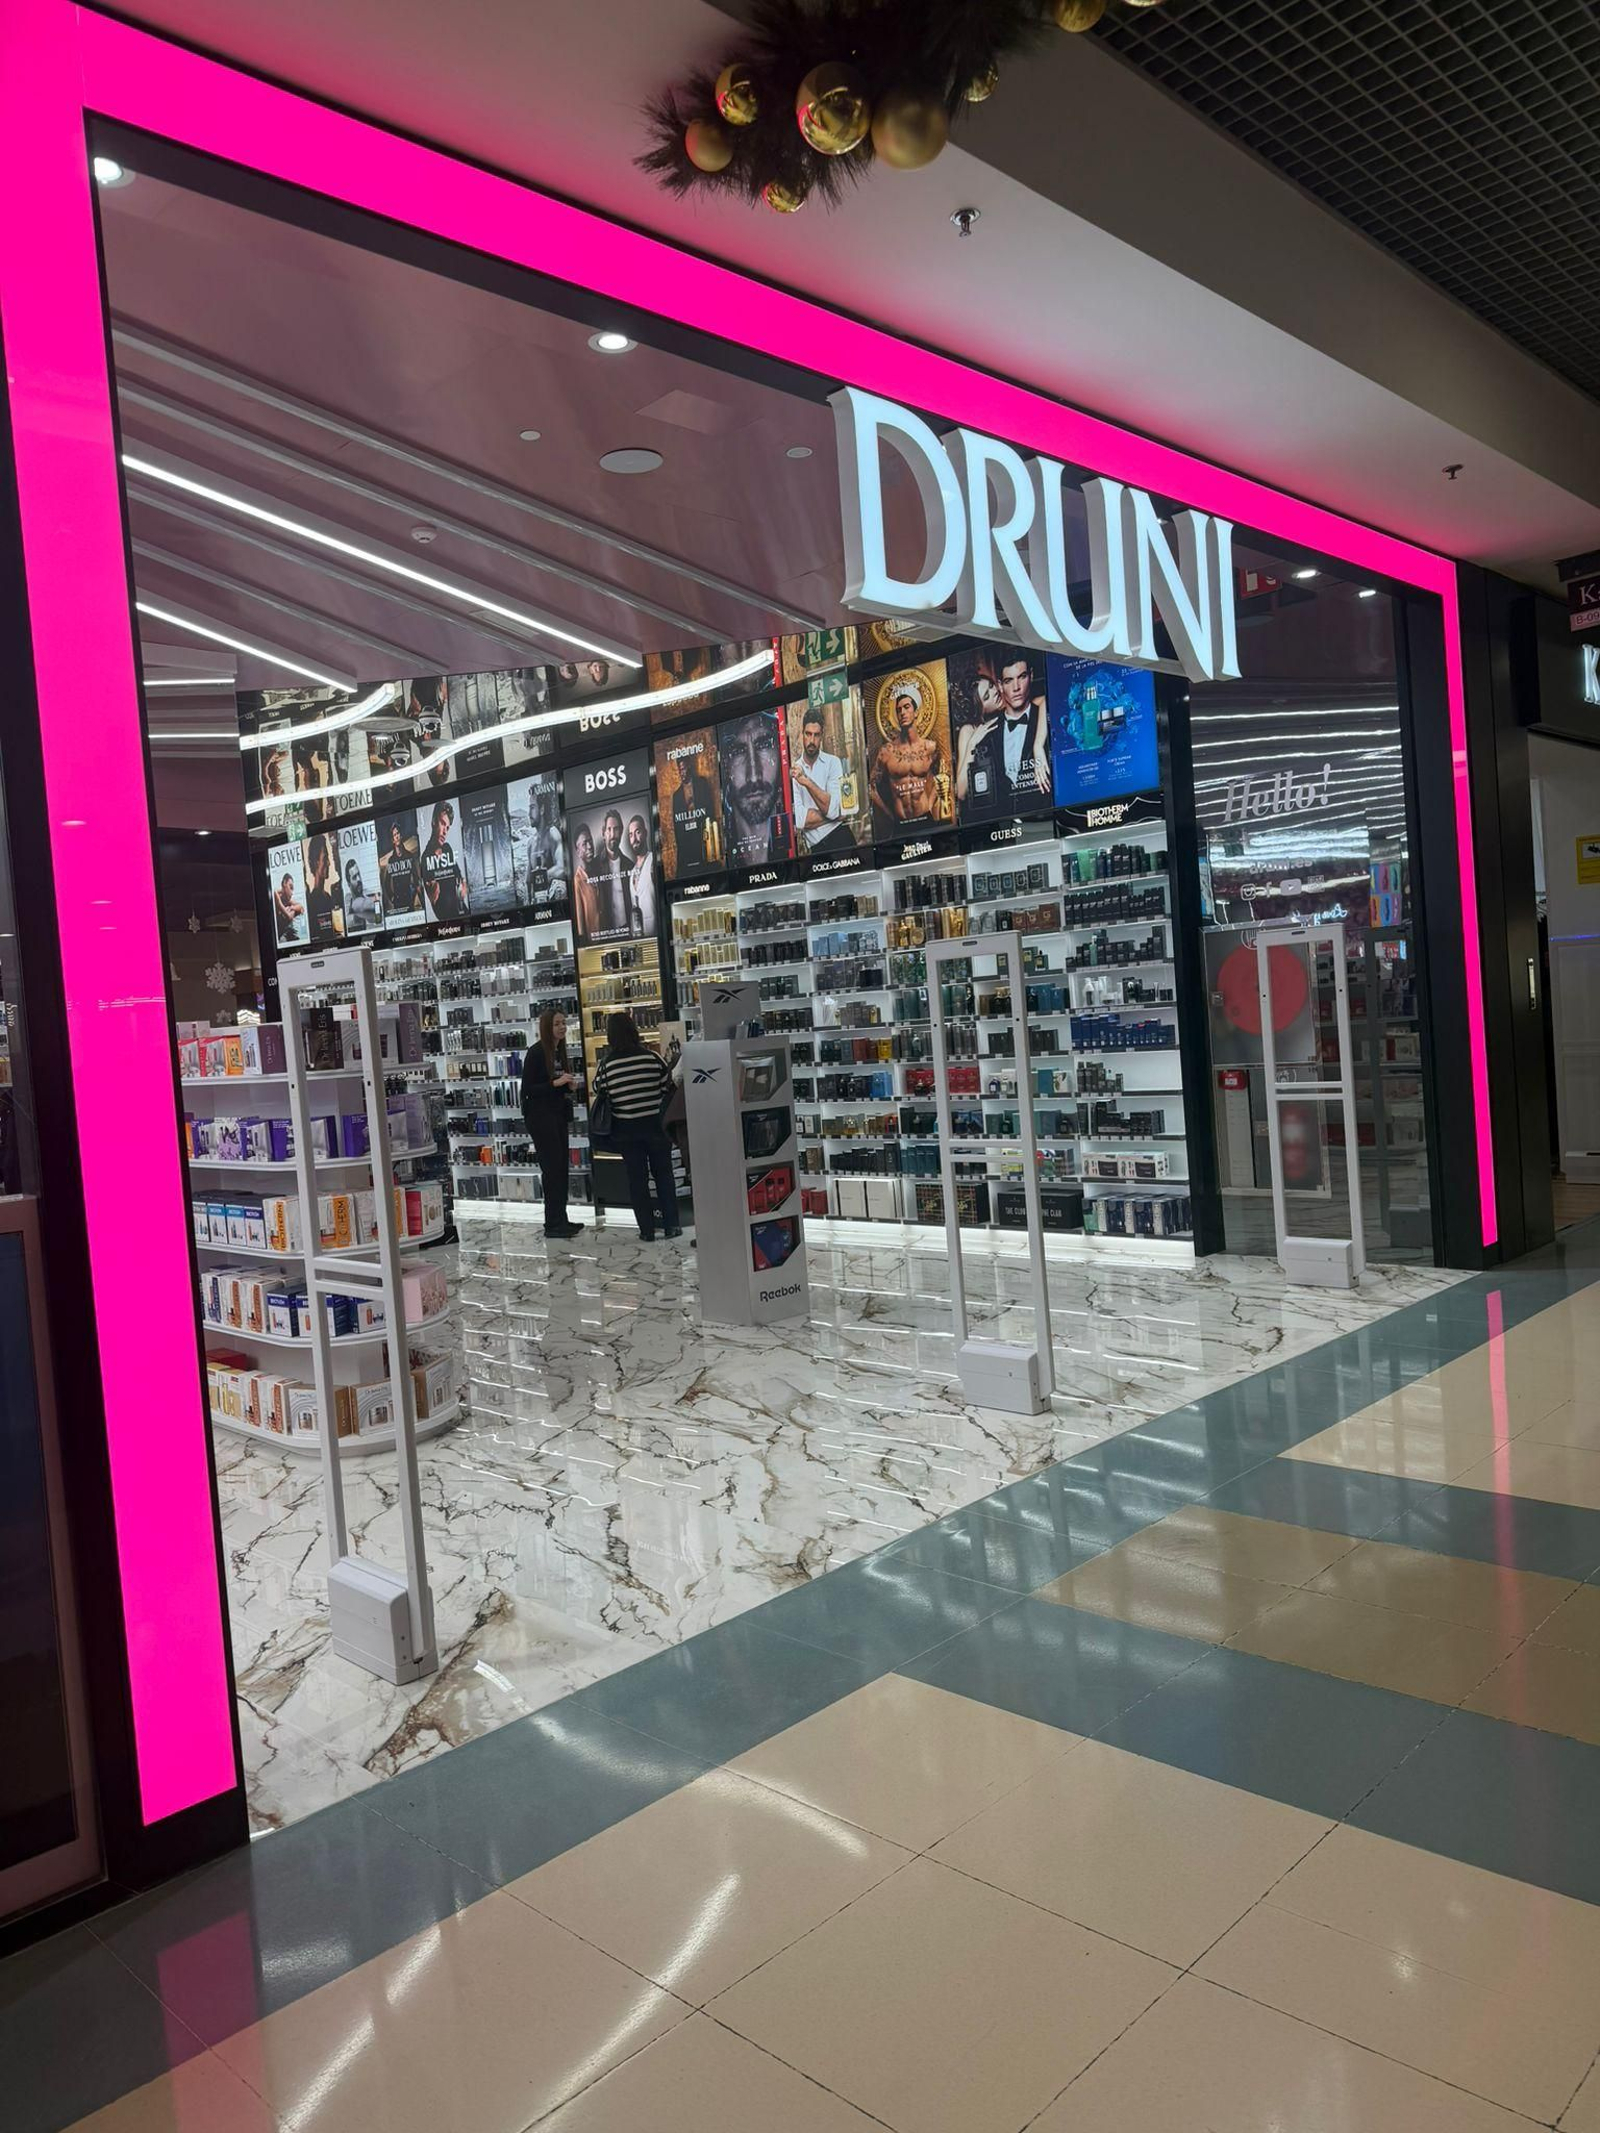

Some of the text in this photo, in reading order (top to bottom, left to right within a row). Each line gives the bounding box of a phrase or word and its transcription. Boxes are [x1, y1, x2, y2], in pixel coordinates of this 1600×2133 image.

[827, 386, 1242, 683] DRUNI
[1580, 583, 1600, 605] K
[667, 742, 704, 761] rabanne
[584, 764, 627, 794] BOSS
[1222, 762, 1331, 823] Hello!
[675, 808, 706, 823] MILLION
[1091, 803, 1129, 818] BIOTHERM
[1091, 814, 1123, 827] HOMME
[338, 825, 376, 850] LOEWE
[990, 827, 1022, 841] GUESS
[269, 845, 302, 869] LOEWE
[426, 850, 459, 871] MYSLF
[749, 871, 778, 884] PRADA
[684, 883, 711, 896] rabanne
[760, 1283, 801, 1303] Reebok
